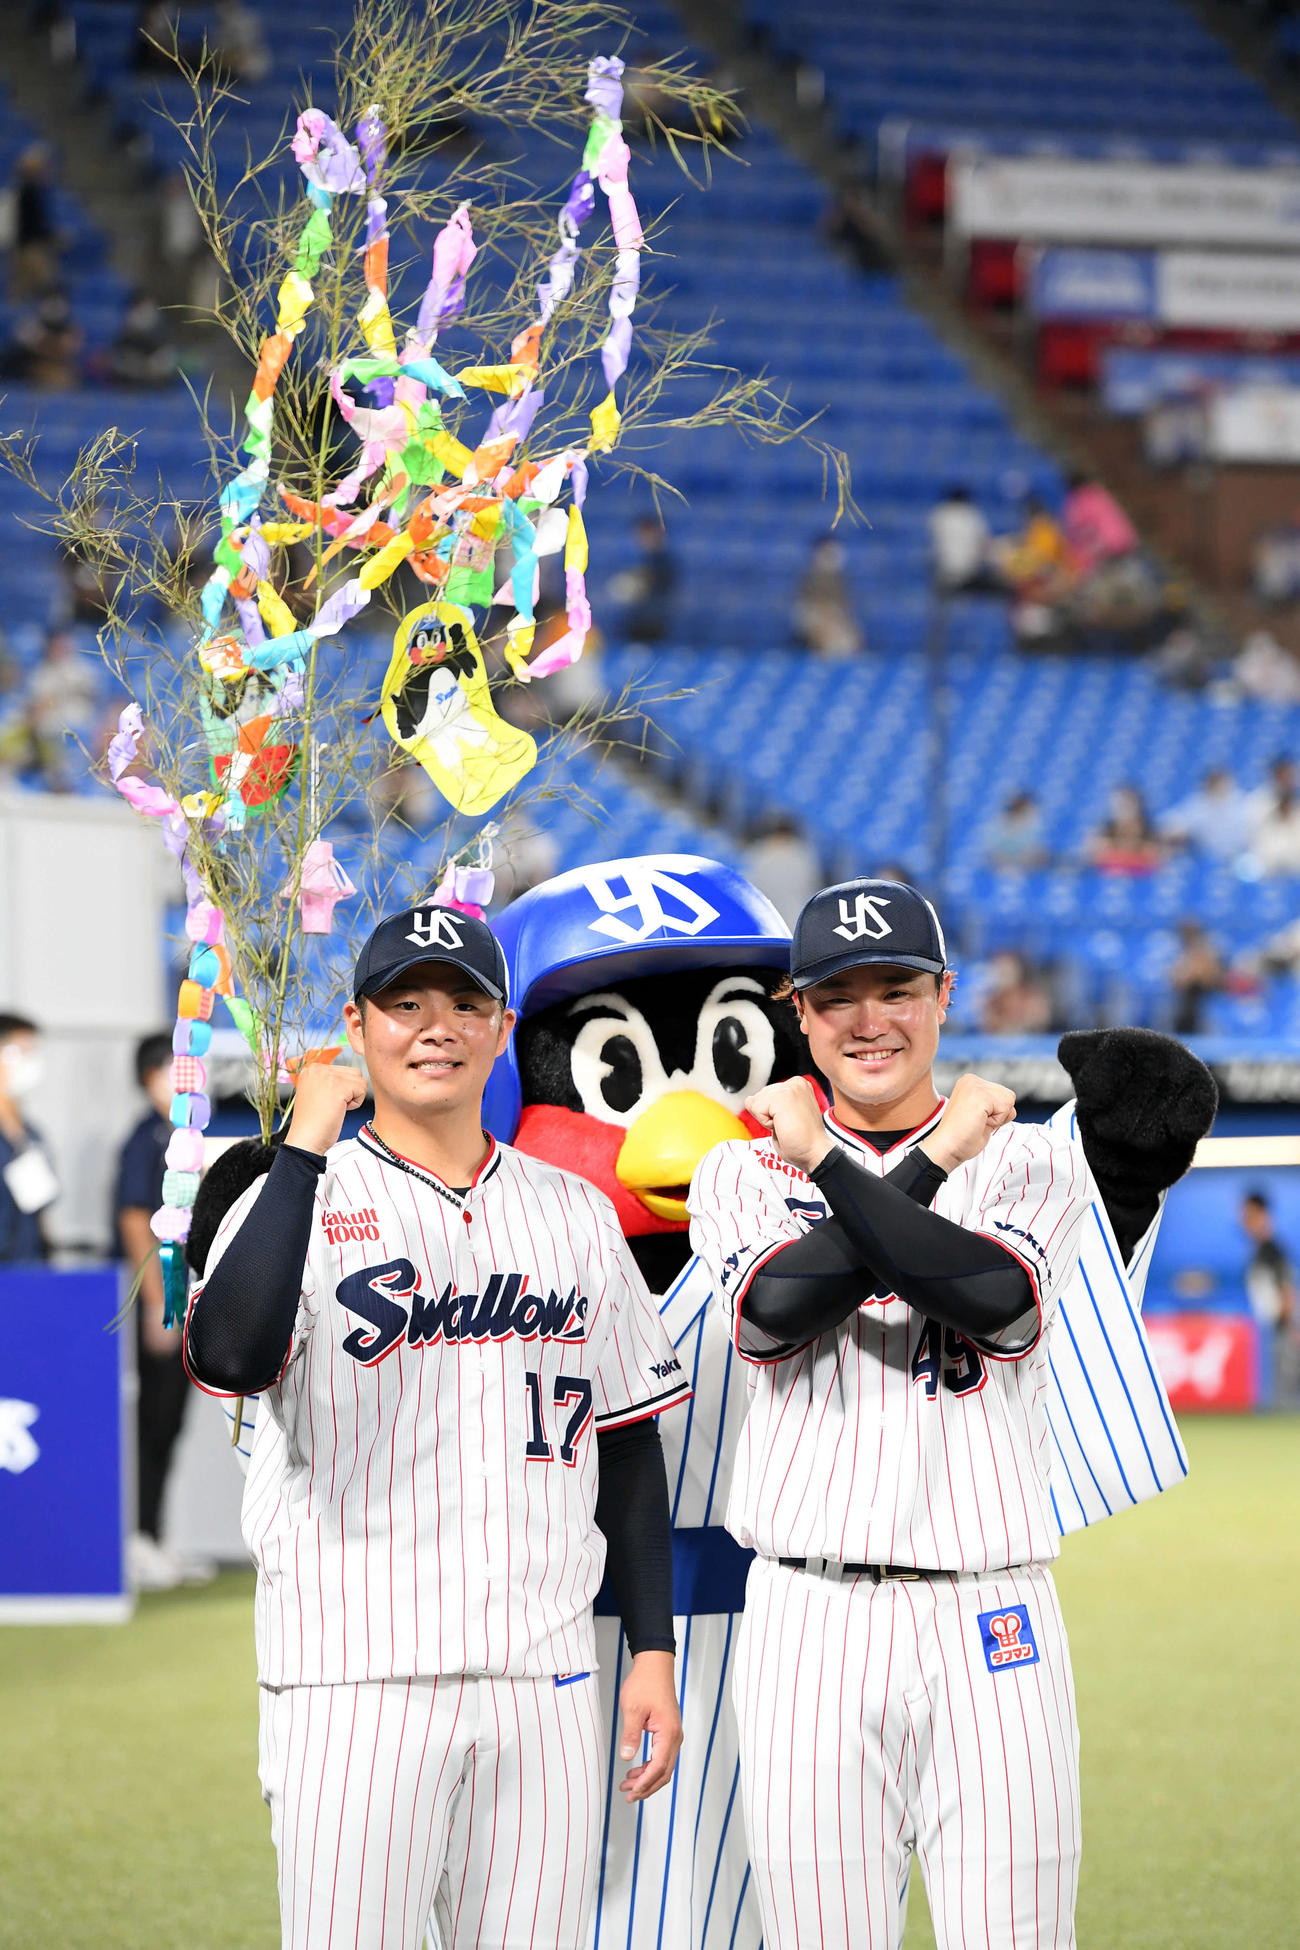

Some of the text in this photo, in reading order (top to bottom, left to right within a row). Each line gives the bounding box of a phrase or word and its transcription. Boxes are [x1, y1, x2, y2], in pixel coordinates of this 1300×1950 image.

[323, 1224, 380, 1245] 1000
[335, 1257, 589, 1368] Swallows
[525, 1371, 594, 1468] 17
[992, 1645, 1031, 1664] タフマン
